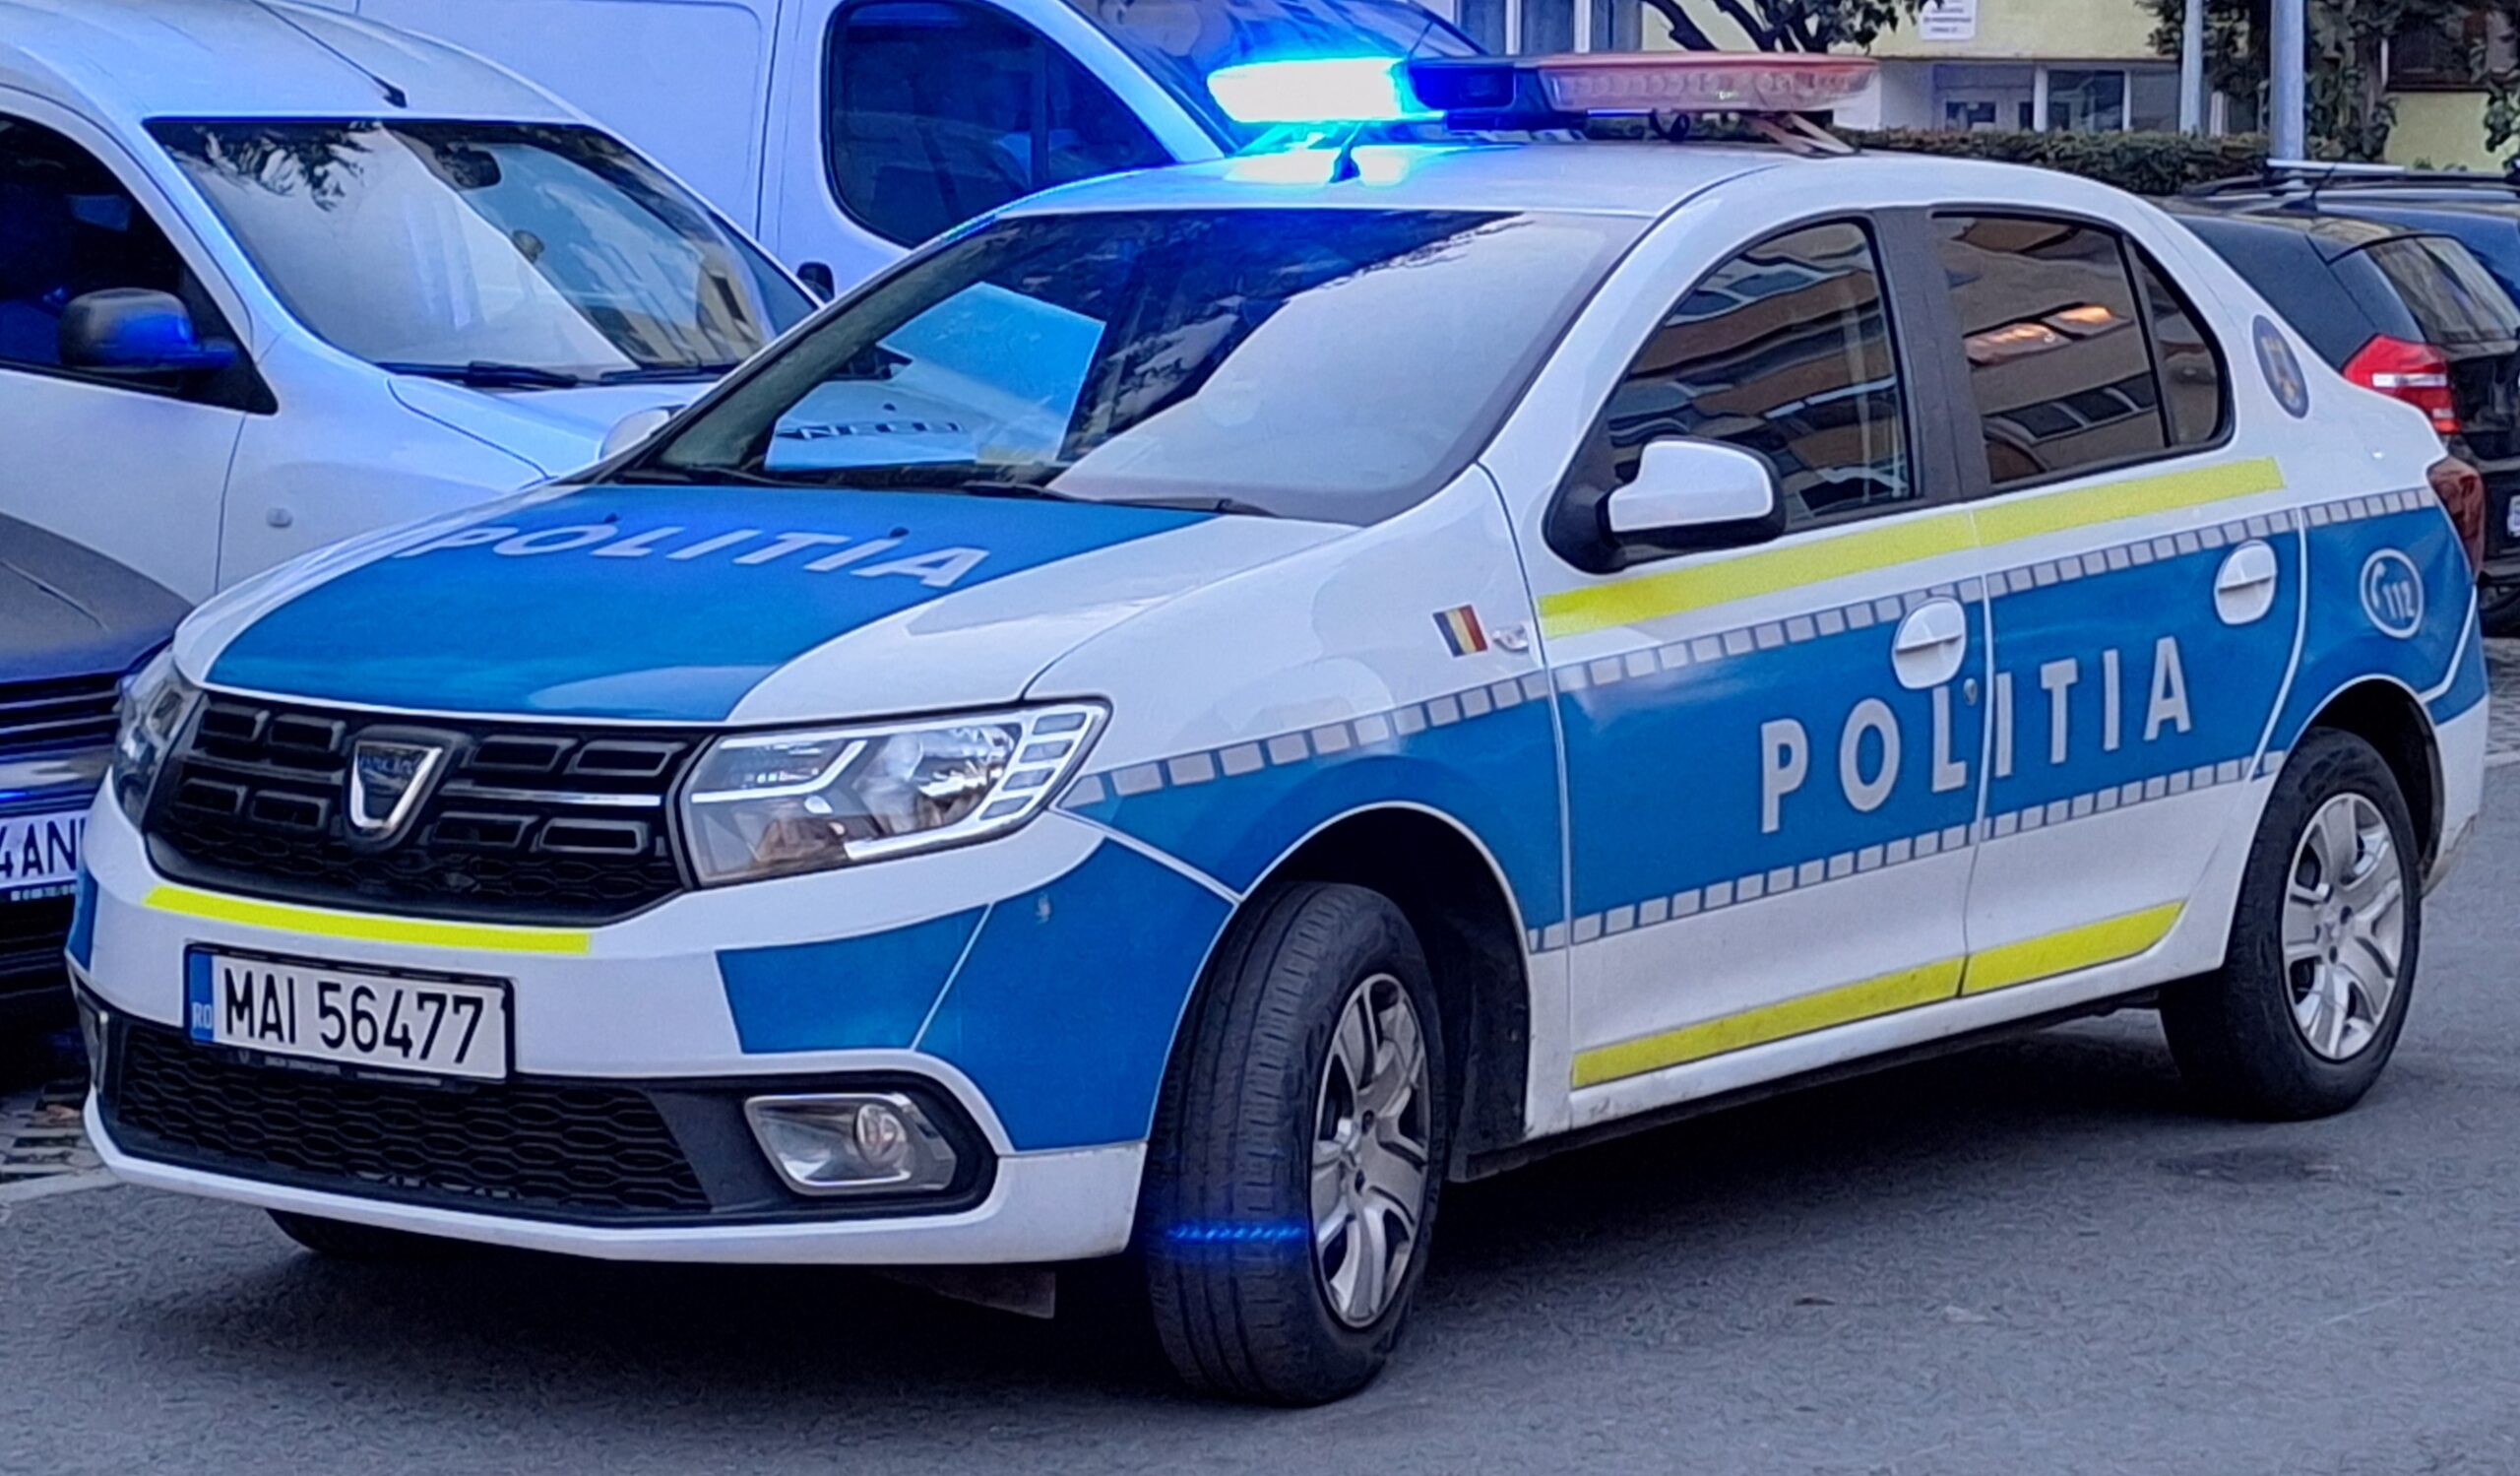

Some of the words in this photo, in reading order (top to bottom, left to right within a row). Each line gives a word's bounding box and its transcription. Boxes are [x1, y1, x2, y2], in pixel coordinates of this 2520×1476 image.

[392, 525, 990, 588] POLITIA
[1761, 636, 2191, 834] POLITIA
[192, 1000, 213, 1029] RO
[223, 968, 296, 1045] MAI
[317, 981, 484, 1064] 56477
